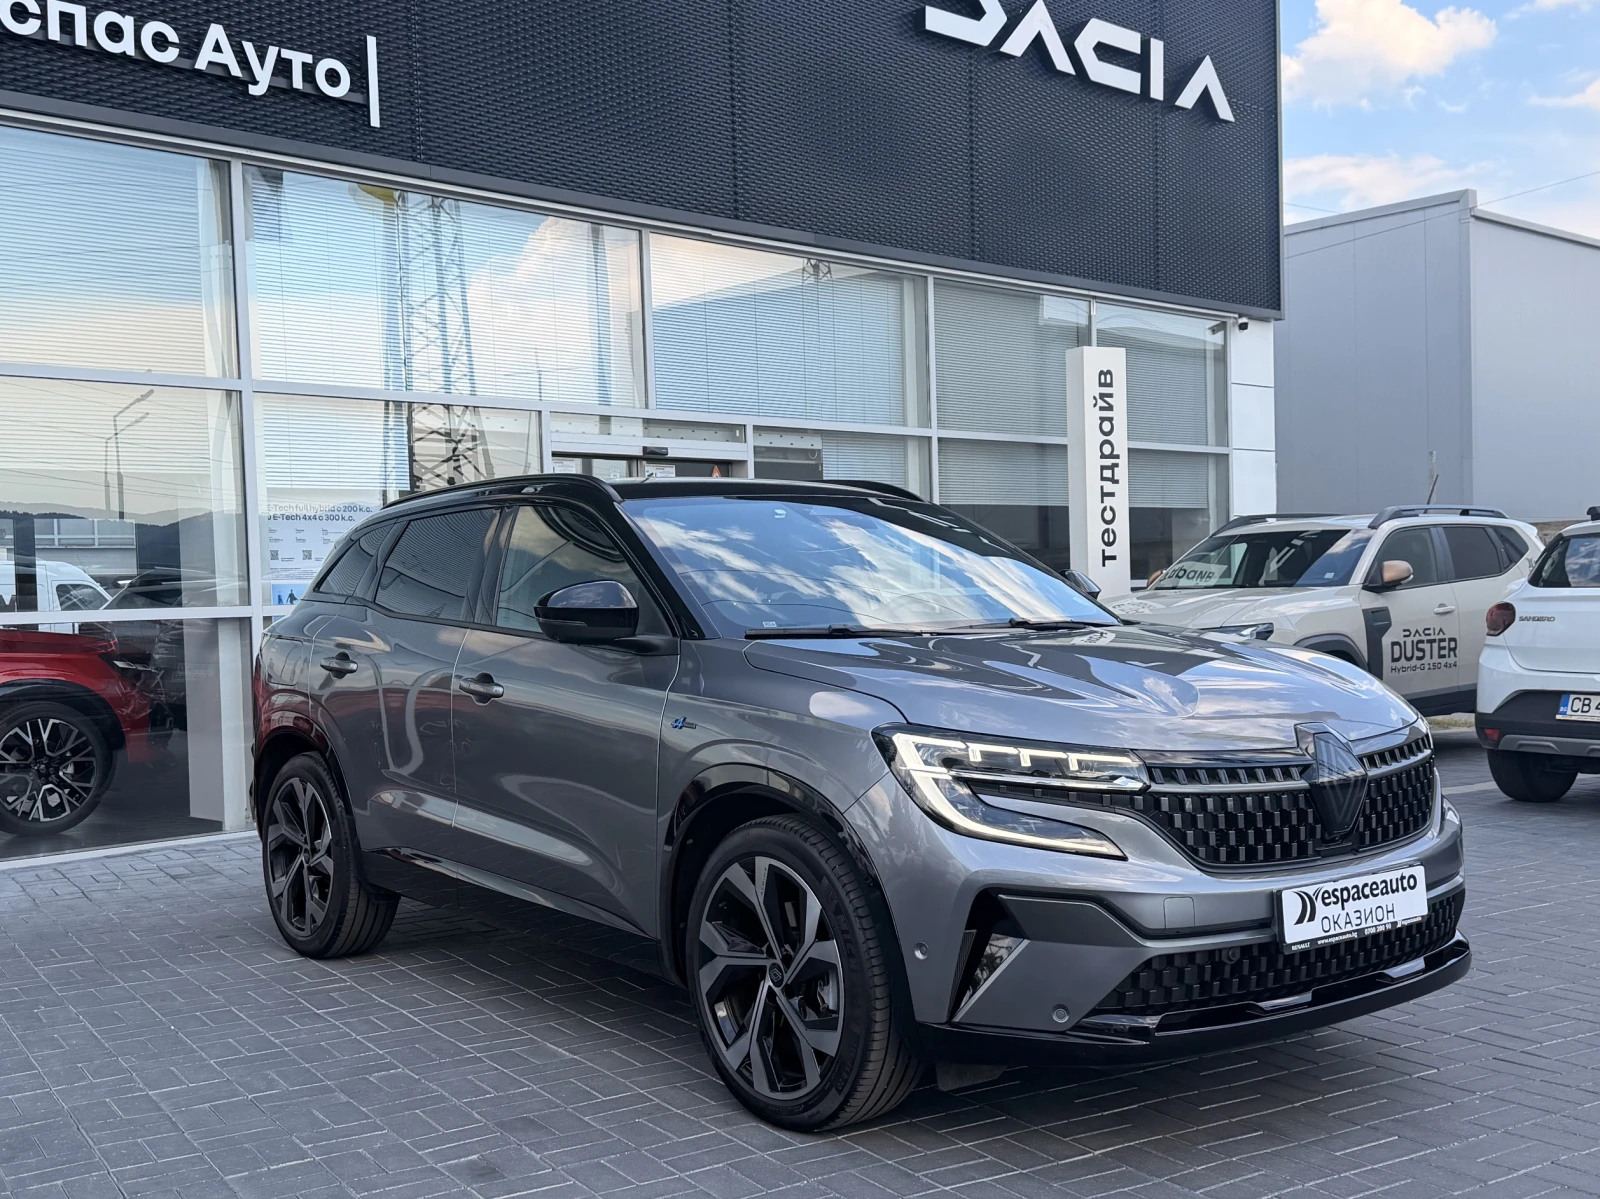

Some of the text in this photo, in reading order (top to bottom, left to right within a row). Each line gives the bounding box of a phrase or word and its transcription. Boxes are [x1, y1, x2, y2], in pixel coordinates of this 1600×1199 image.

[194, 23, 350, 98] Ауто
[1093, 368, 1120, 567] тестдрайв
[273, 513, 300, 521] E-Tech
[342, 505, 359, 513] 200
[1402, 627, 1446, 638] DACIA
[1390, 637, 1458, 663] DUSTER
[1390, 661, 1458, 675] Hybrid-G 150 4x4
[1321, 872, 1418, 910] espaceauto
[1321, 903, 1395, 934] ОКАЗИОН
[1291, 942, 1311, 951] RENAULT
[1317, 931, 1358, 945] www.espaceauto.bg
